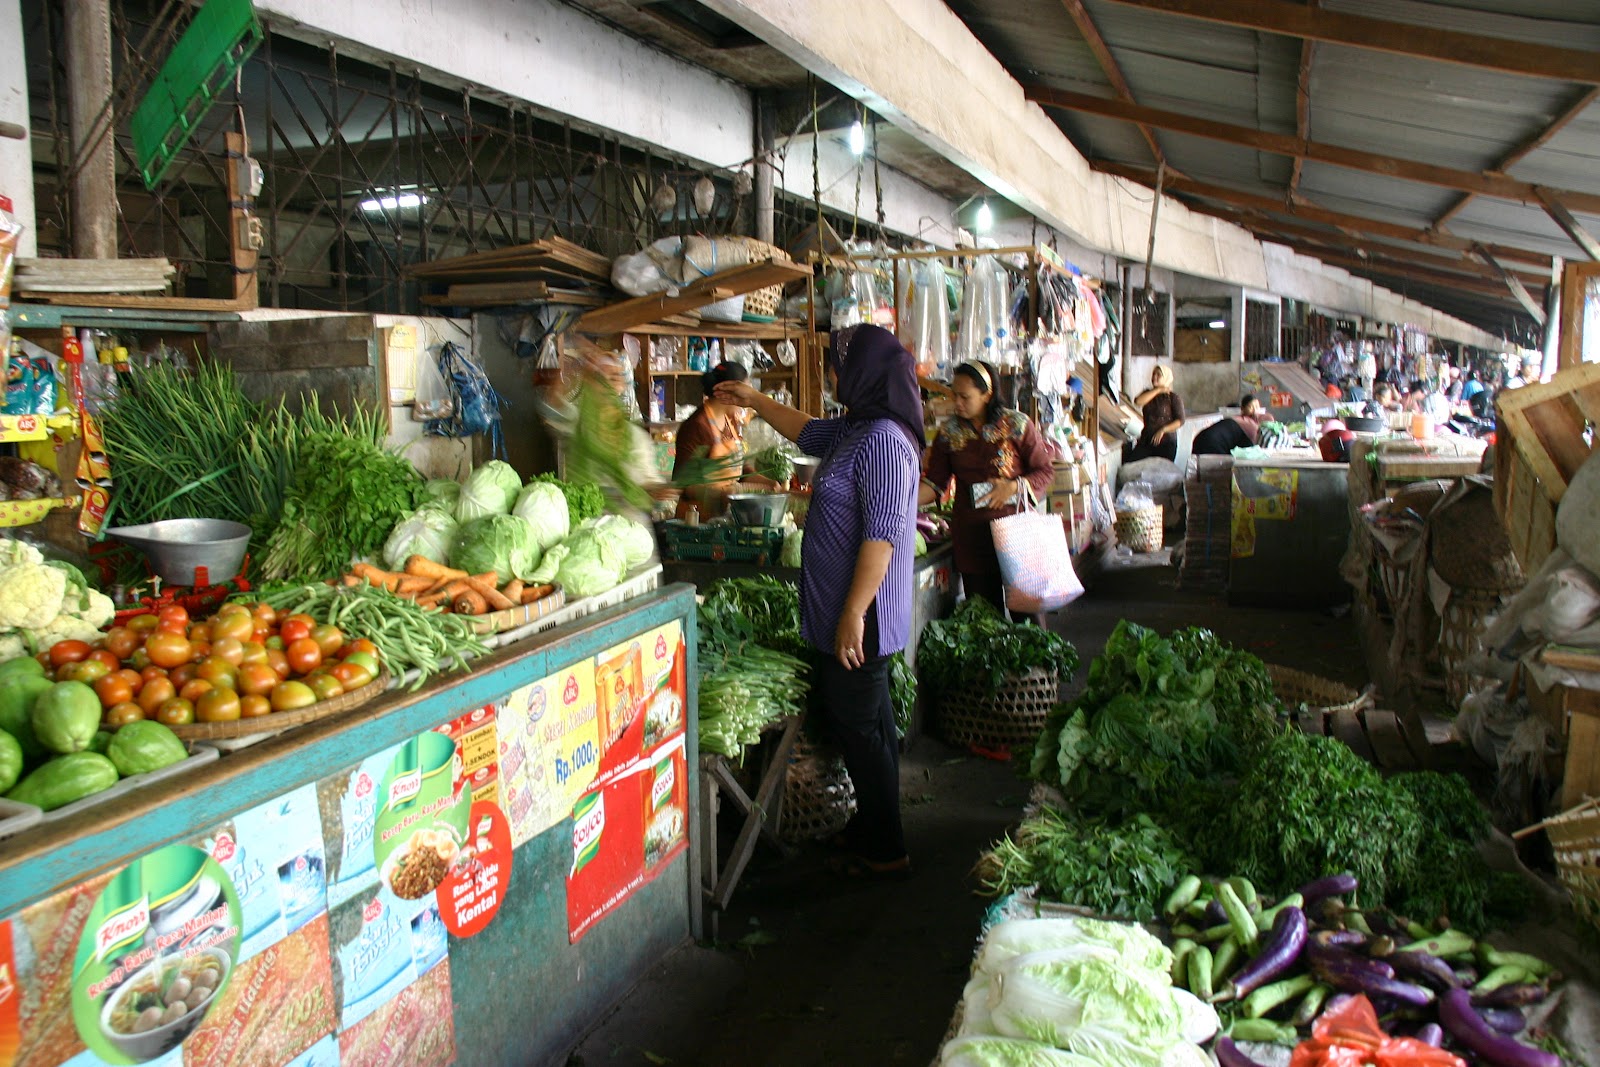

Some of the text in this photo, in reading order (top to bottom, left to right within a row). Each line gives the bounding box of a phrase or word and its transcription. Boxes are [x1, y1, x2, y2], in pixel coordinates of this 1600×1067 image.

[20, 420, 36, 429] ABC
[564, 689, 578, 703] ABC
[555, 740, 598, 785] Rp.1000,-
[391, 778, 419, 799] Knorr
[655, 771, 673, 800] Royco
[573, 809, 602, 849] Royco
[453, 879, 474, 898] Rasa
[454, 891, 475, 913] yang
[457, 889, 497, 928] Kental
[101, 910, 146, 947] Knorr
[88, 966, 124, 999] Resep
[156, 928, 184, 951] Rasa
